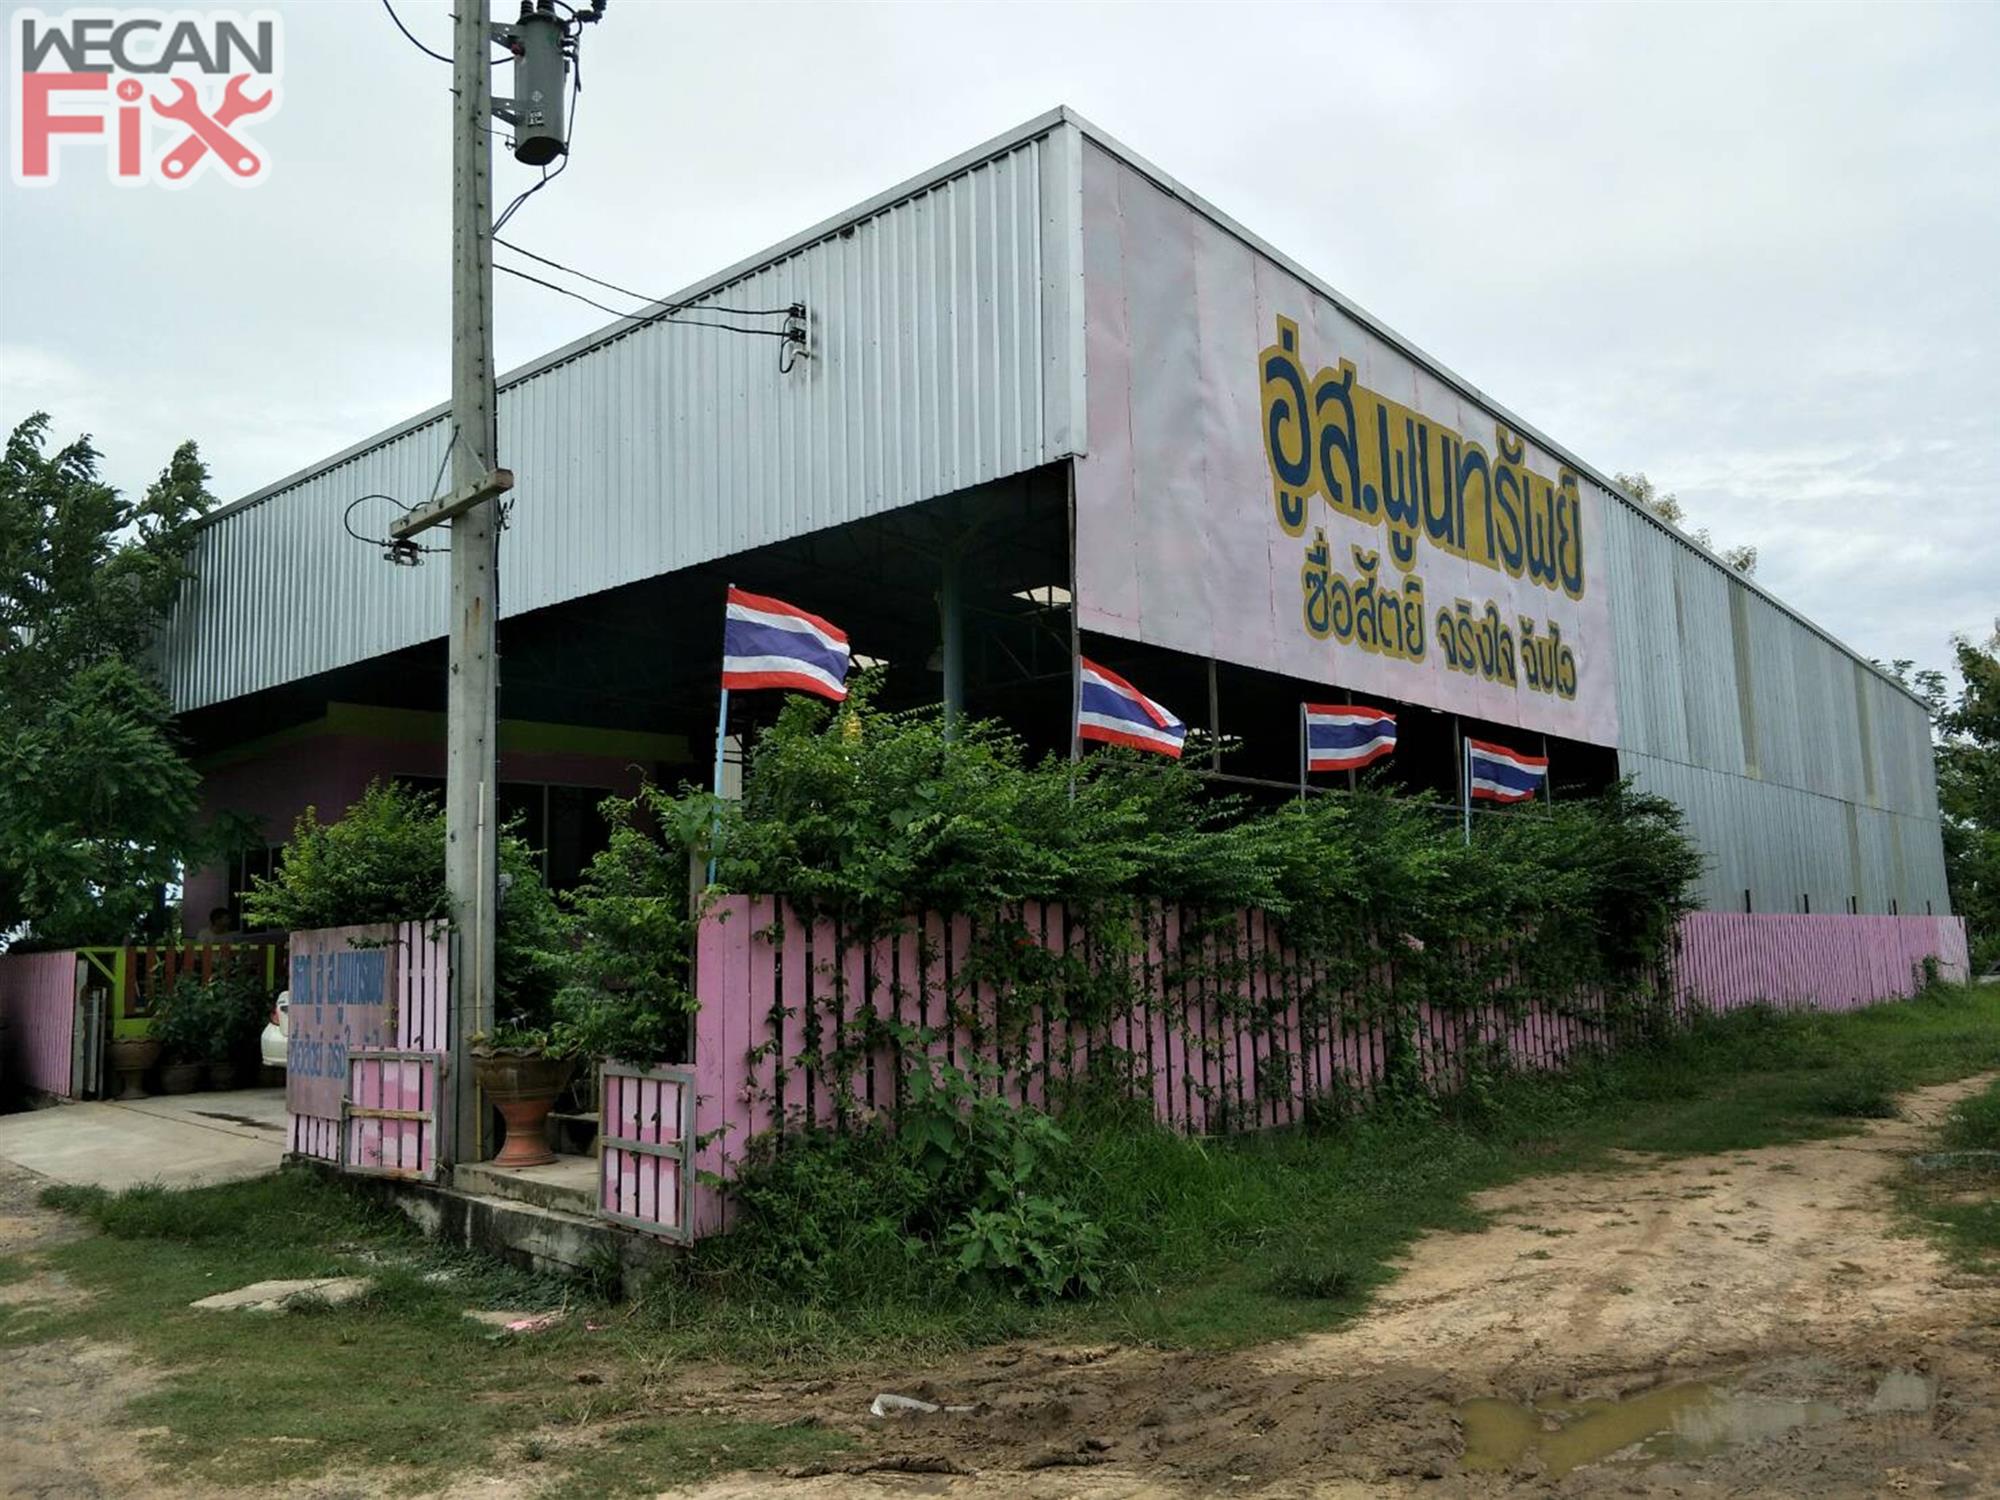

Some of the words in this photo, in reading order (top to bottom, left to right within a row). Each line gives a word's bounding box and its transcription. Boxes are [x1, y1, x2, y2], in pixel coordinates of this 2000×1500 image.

[1436, 598, 1517, 688] จริงใจ
[1518, 615, 1577, 700] ฉับไว
